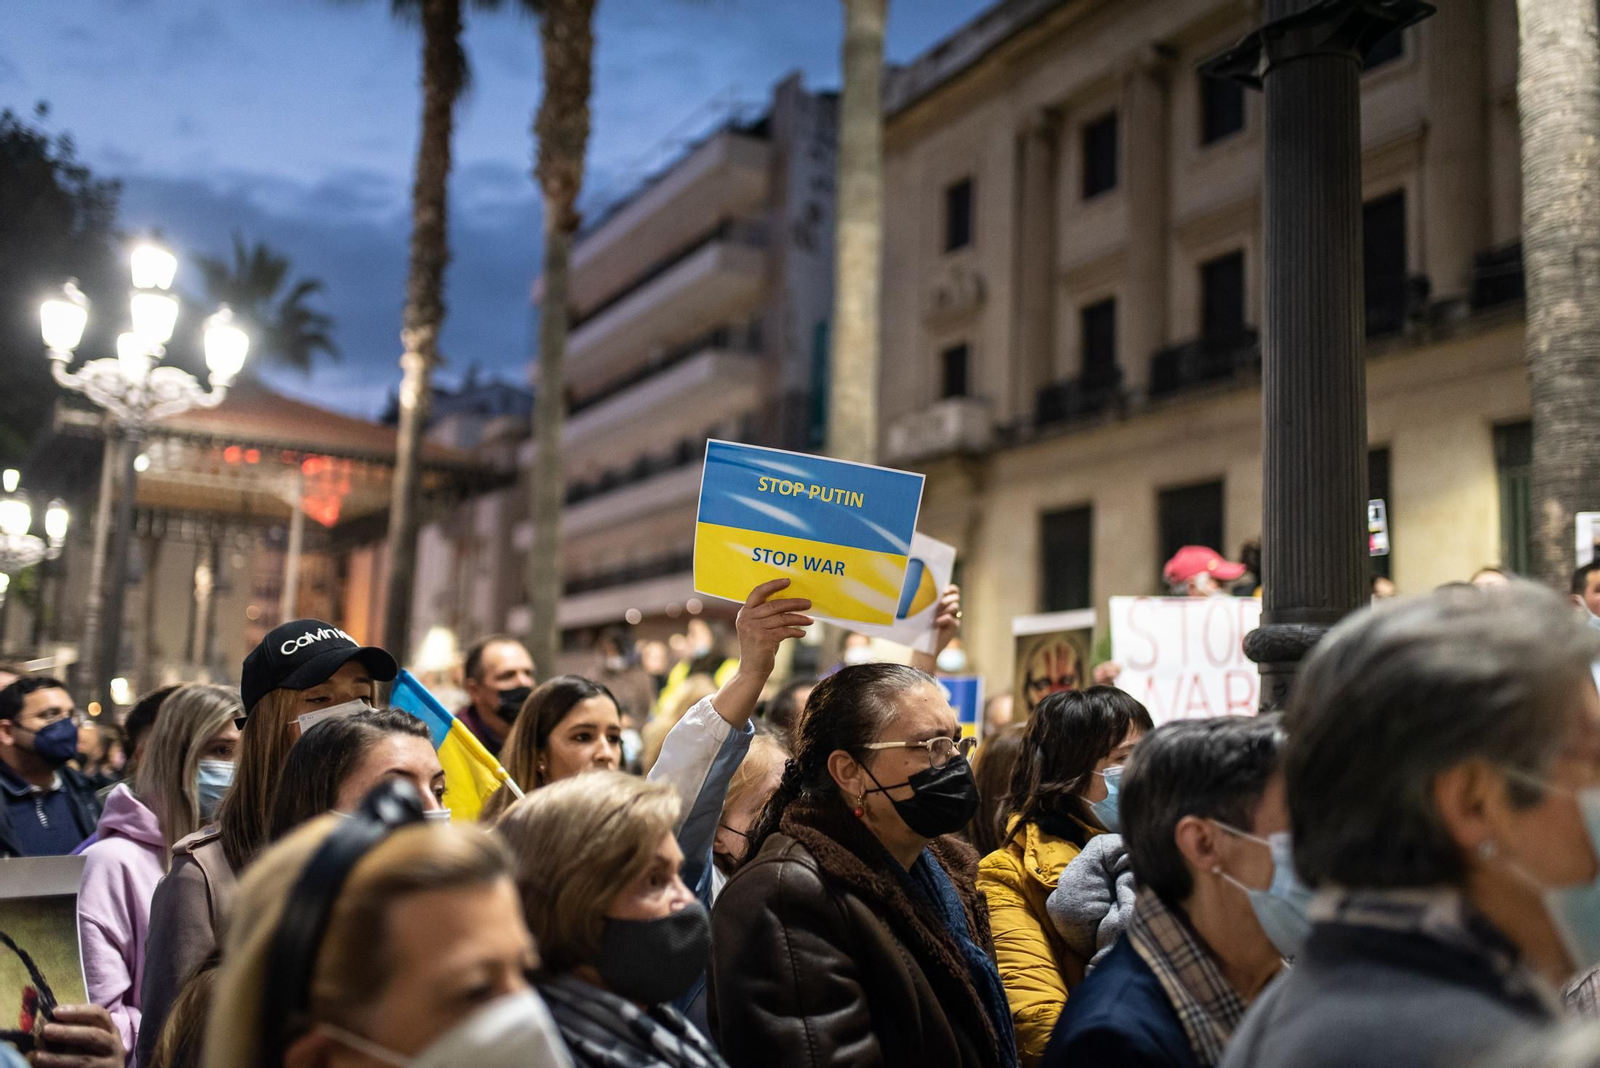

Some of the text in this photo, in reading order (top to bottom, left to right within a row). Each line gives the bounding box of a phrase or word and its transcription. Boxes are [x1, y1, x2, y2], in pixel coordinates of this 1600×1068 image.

[757, 476, 864, 508] STOP PUTIN
[751, 547, 846, 576] STOP WAR
